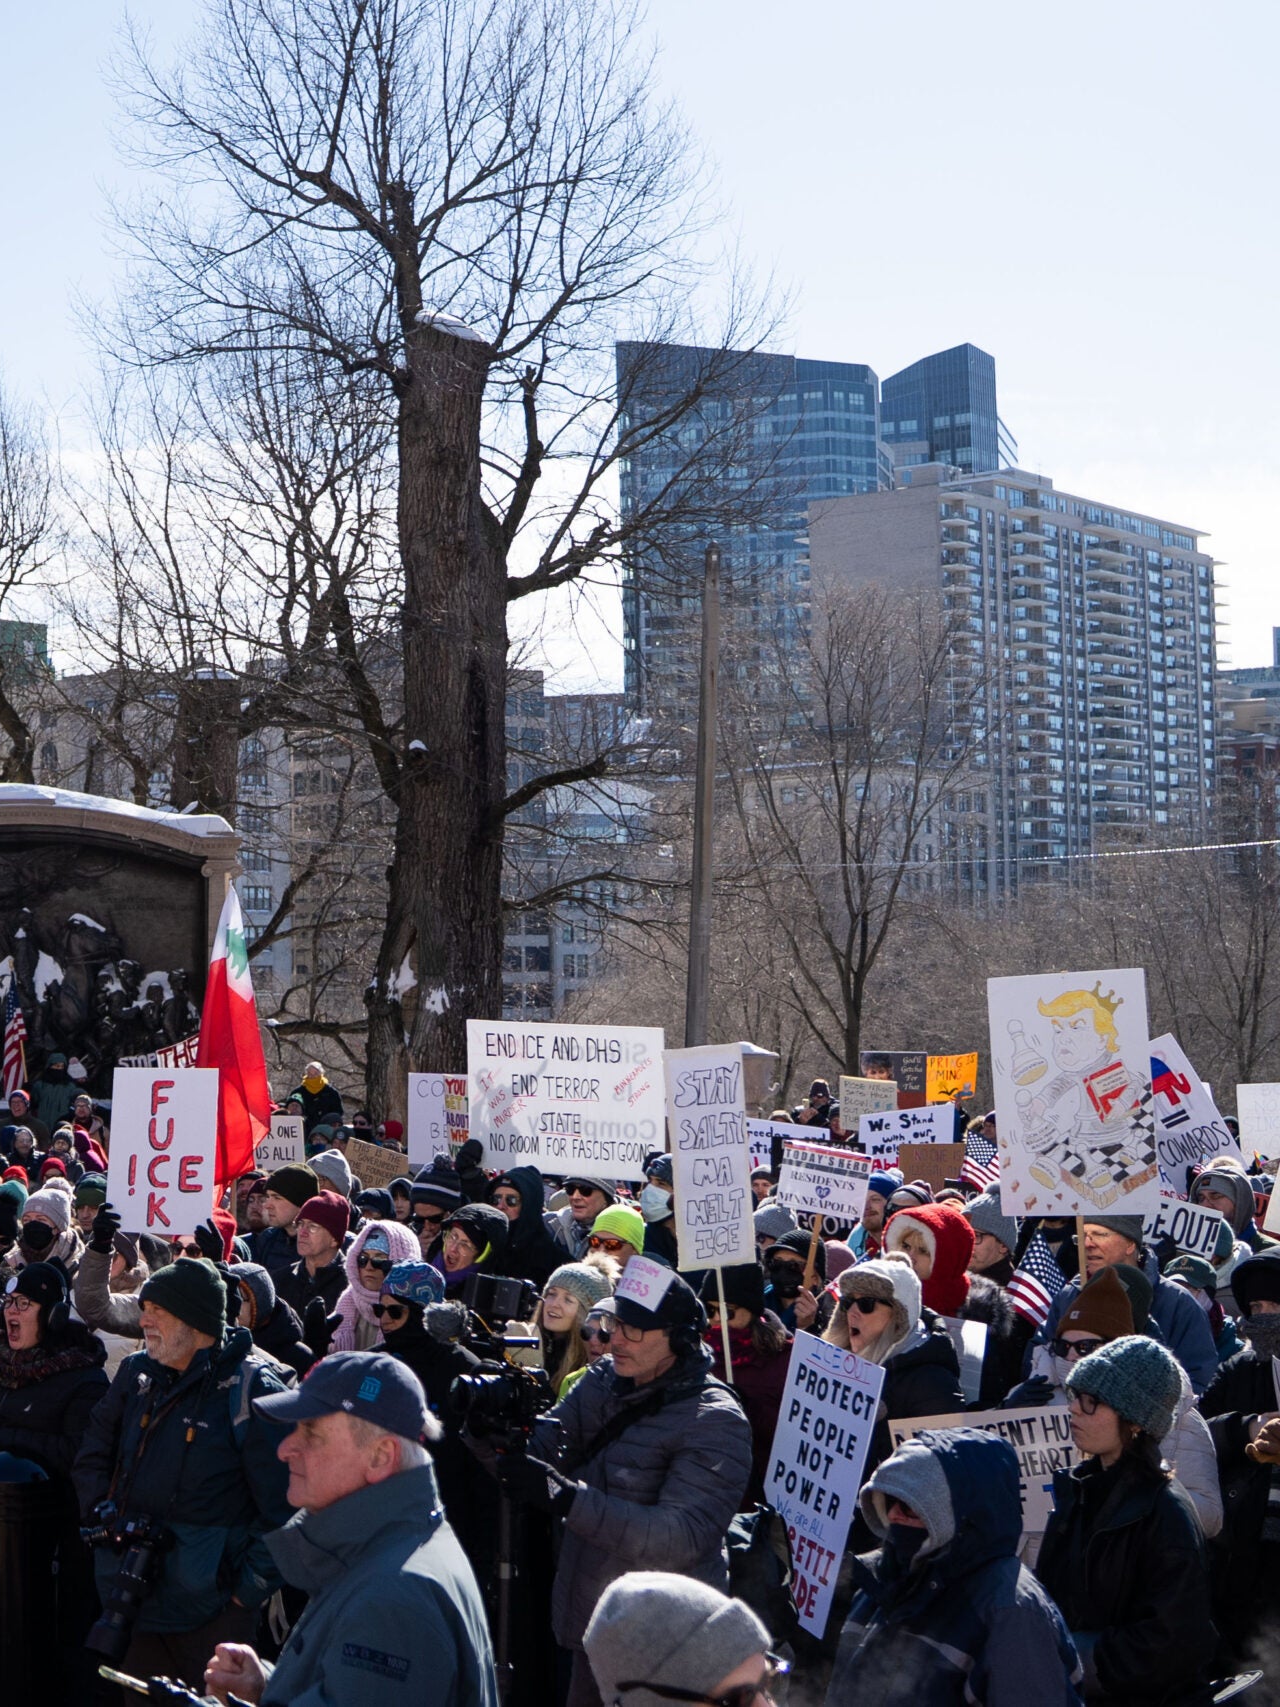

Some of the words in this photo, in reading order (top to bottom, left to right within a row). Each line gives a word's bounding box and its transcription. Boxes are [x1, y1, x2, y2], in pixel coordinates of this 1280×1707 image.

[486, 1032, 517, 1058] END
[522, 1035, 545, 1060] ICE
[552, 1036, 580, 1062] AND
[586, 1038, 620, 1064] DHS
[966, 1054, 976, 1065] IS
[445, 1078, 467, 1096] YOU
[480, 1070, 495, 1092] IT
[512, 1074, 538, 1096] END
[543, 1075, 600, 1100] TERROR
[674, 1061, 740, 1108] STAY
[488, 1090, 506, 1110] WAS
[492, 1098, 528, 1129] MURDER
[277, 1125, 298, 1138] ONE
[538, 1111, 582, 1134] STATE
[678, 1111, 745, 1150] SALTY
[868, 1118, 890, 1132] We
[898, 1112, 935, 1129] Stand
[256, 1148, 270, 1160] US
[272, 1146, 296, 1162] ALL!
[490, 1132, 506, 1152] NO
[509, 1135, 540, 1155] ROOM
[546, 1136, 568, 1158] FOR
[572, 1138, 617, 1162] FASCIST
[882, 1134, 906, 1144] with
[1158, 1121, 1230, 1168] COWARDS
[692, 1156, 734, 1187] MA
[786, 1148, 835, 1167] TODAY'S
[839, 1157, 869, 1173] HERO
[790, 1170, 856, 1192] RESIDENTS
[686, 1188, 744, 1226] MELT
[778, 1190, 859, 1216] MINNEAPOLIS
[695, 1222, 740, 1260] ICE
[1171, 1207, 1220, 1254] OUT!
[811, 1338, 842, 1368] ICE
[844, 1354, 872, 1382] OUT
[794, 1362, 876, 1421] PROTECT
[788, 1398, 858, 1460] PEOPLE
[1040, 1414, 1072, 1444] HU
[796, 1439, 834, 1480] NOT
[773, 1459, 840, 1520] POWER
[776, 1494, 792, 1522] We
[794, 1512, 808, 1530] are
